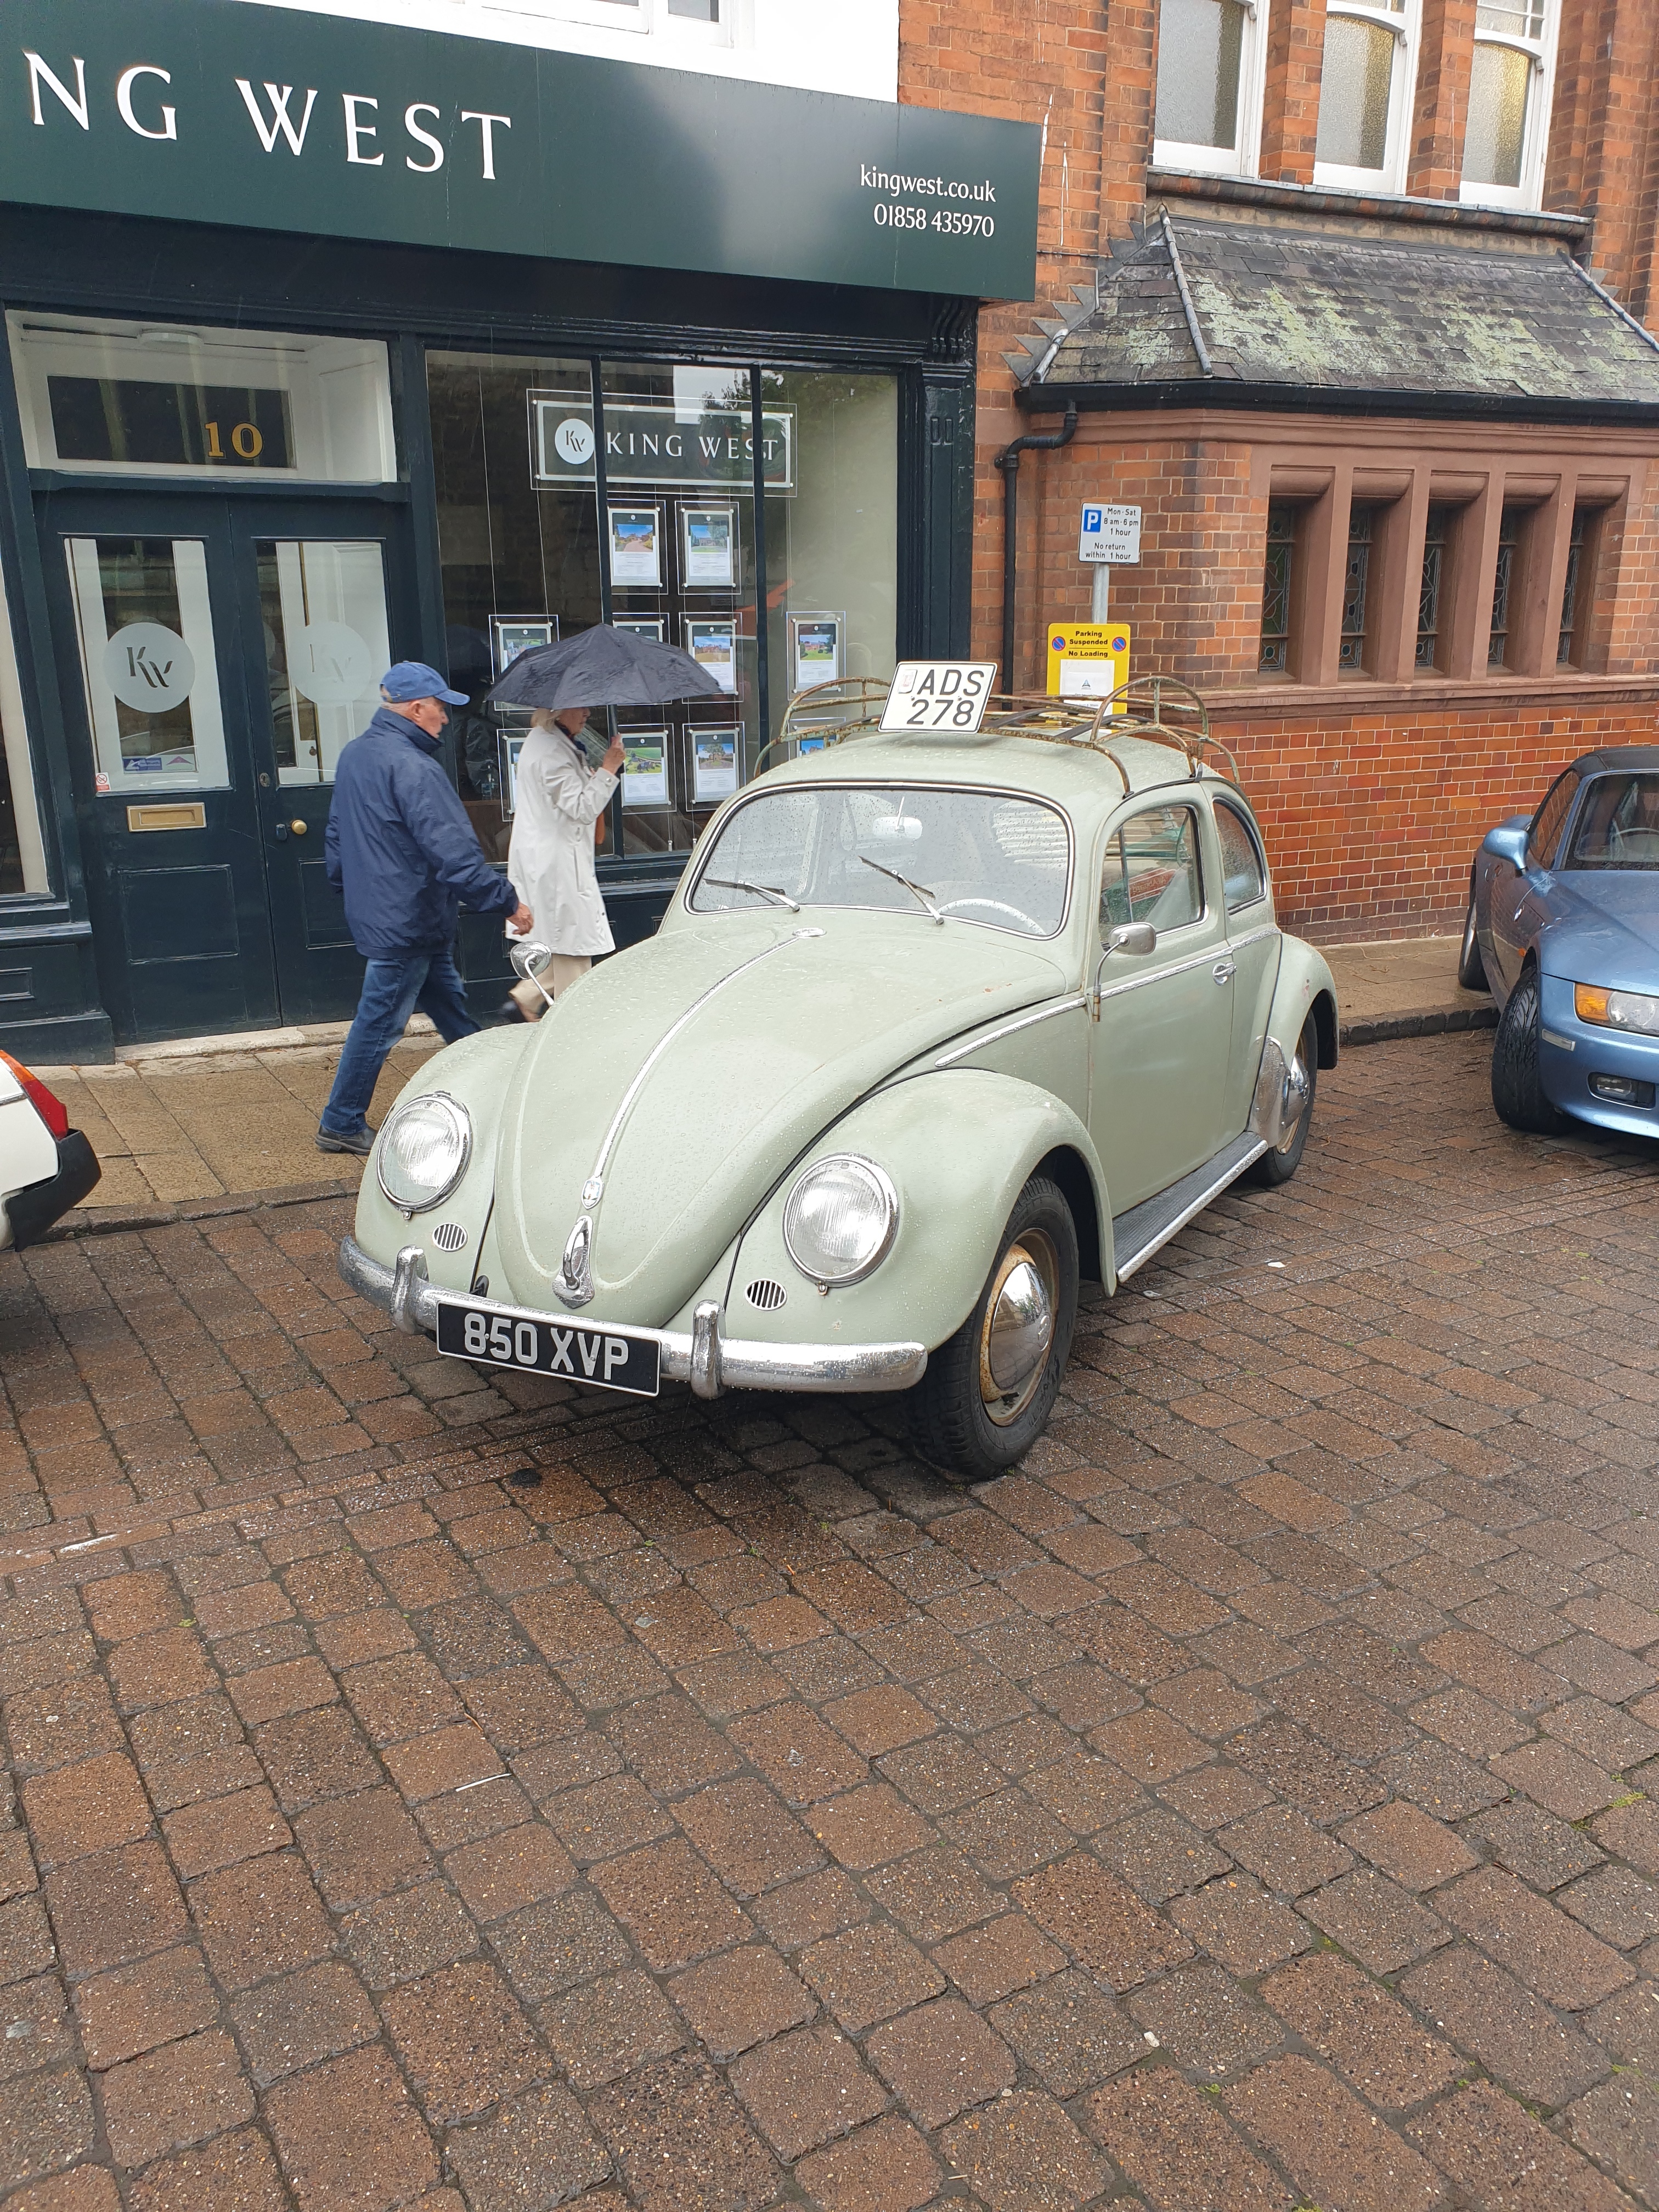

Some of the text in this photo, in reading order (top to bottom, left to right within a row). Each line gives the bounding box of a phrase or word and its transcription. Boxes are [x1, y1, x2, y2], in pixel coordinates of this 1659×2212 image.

[235, 78, 512, 180] WEST
[860, 163, 996, 203] kingwest.co.uk
[873, 203, 995, 237] 01858 435970
[205, 421, 263, 458] 10
[607, 432, 778, 460] KING WEST
[1087, 512, 1099, 530] P
[917, 669, 984, 696] ADS
[907, 699, 974, 726] 278
[464, 1312, 629, 1380] 850 XVP
